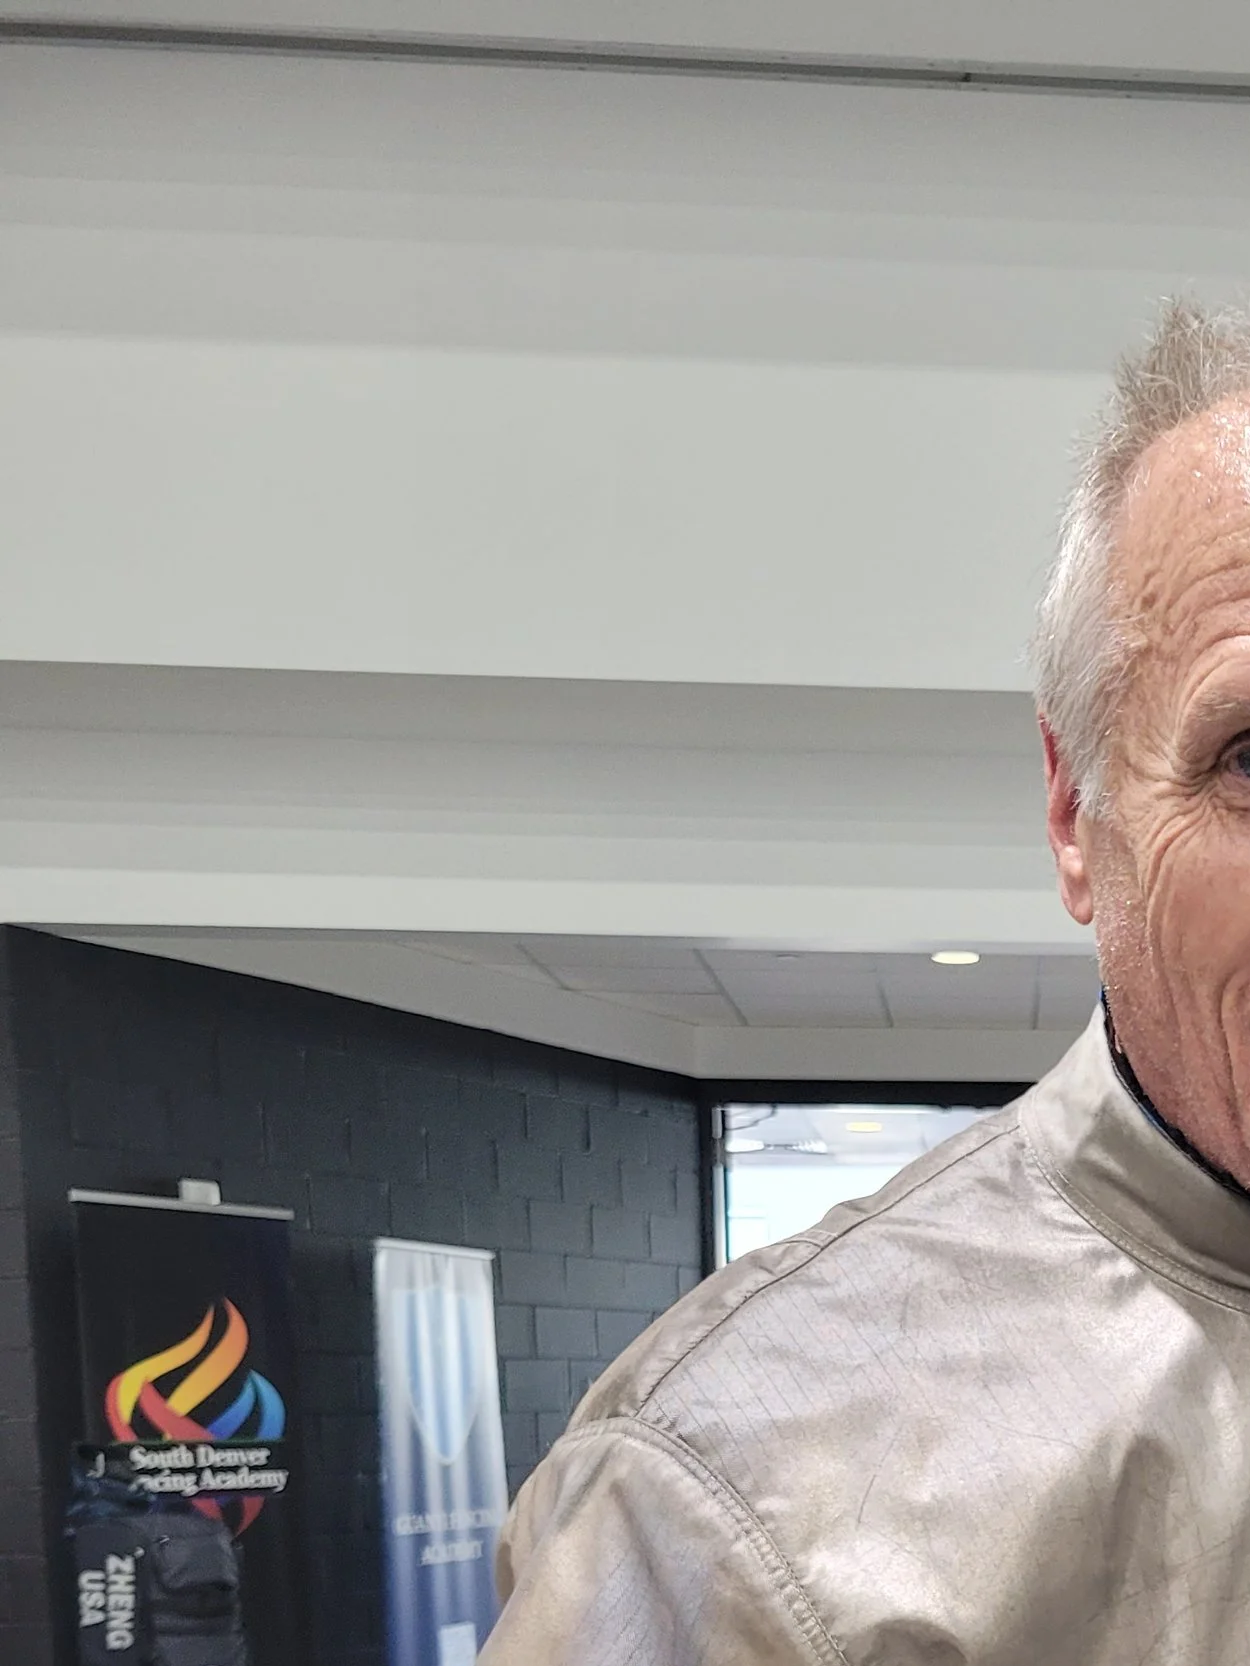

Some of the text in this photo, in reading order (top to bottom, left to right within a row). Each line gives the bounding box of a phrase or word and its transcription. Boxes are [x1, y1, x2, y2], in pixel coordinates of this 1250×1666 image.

[130, 1444, 271, 1469] South Denver
[199, 1466, 289, 1493] Academy
[78, 1570, 106, 1628] USA
[105, 1554, 136, 1651] ZHENG
